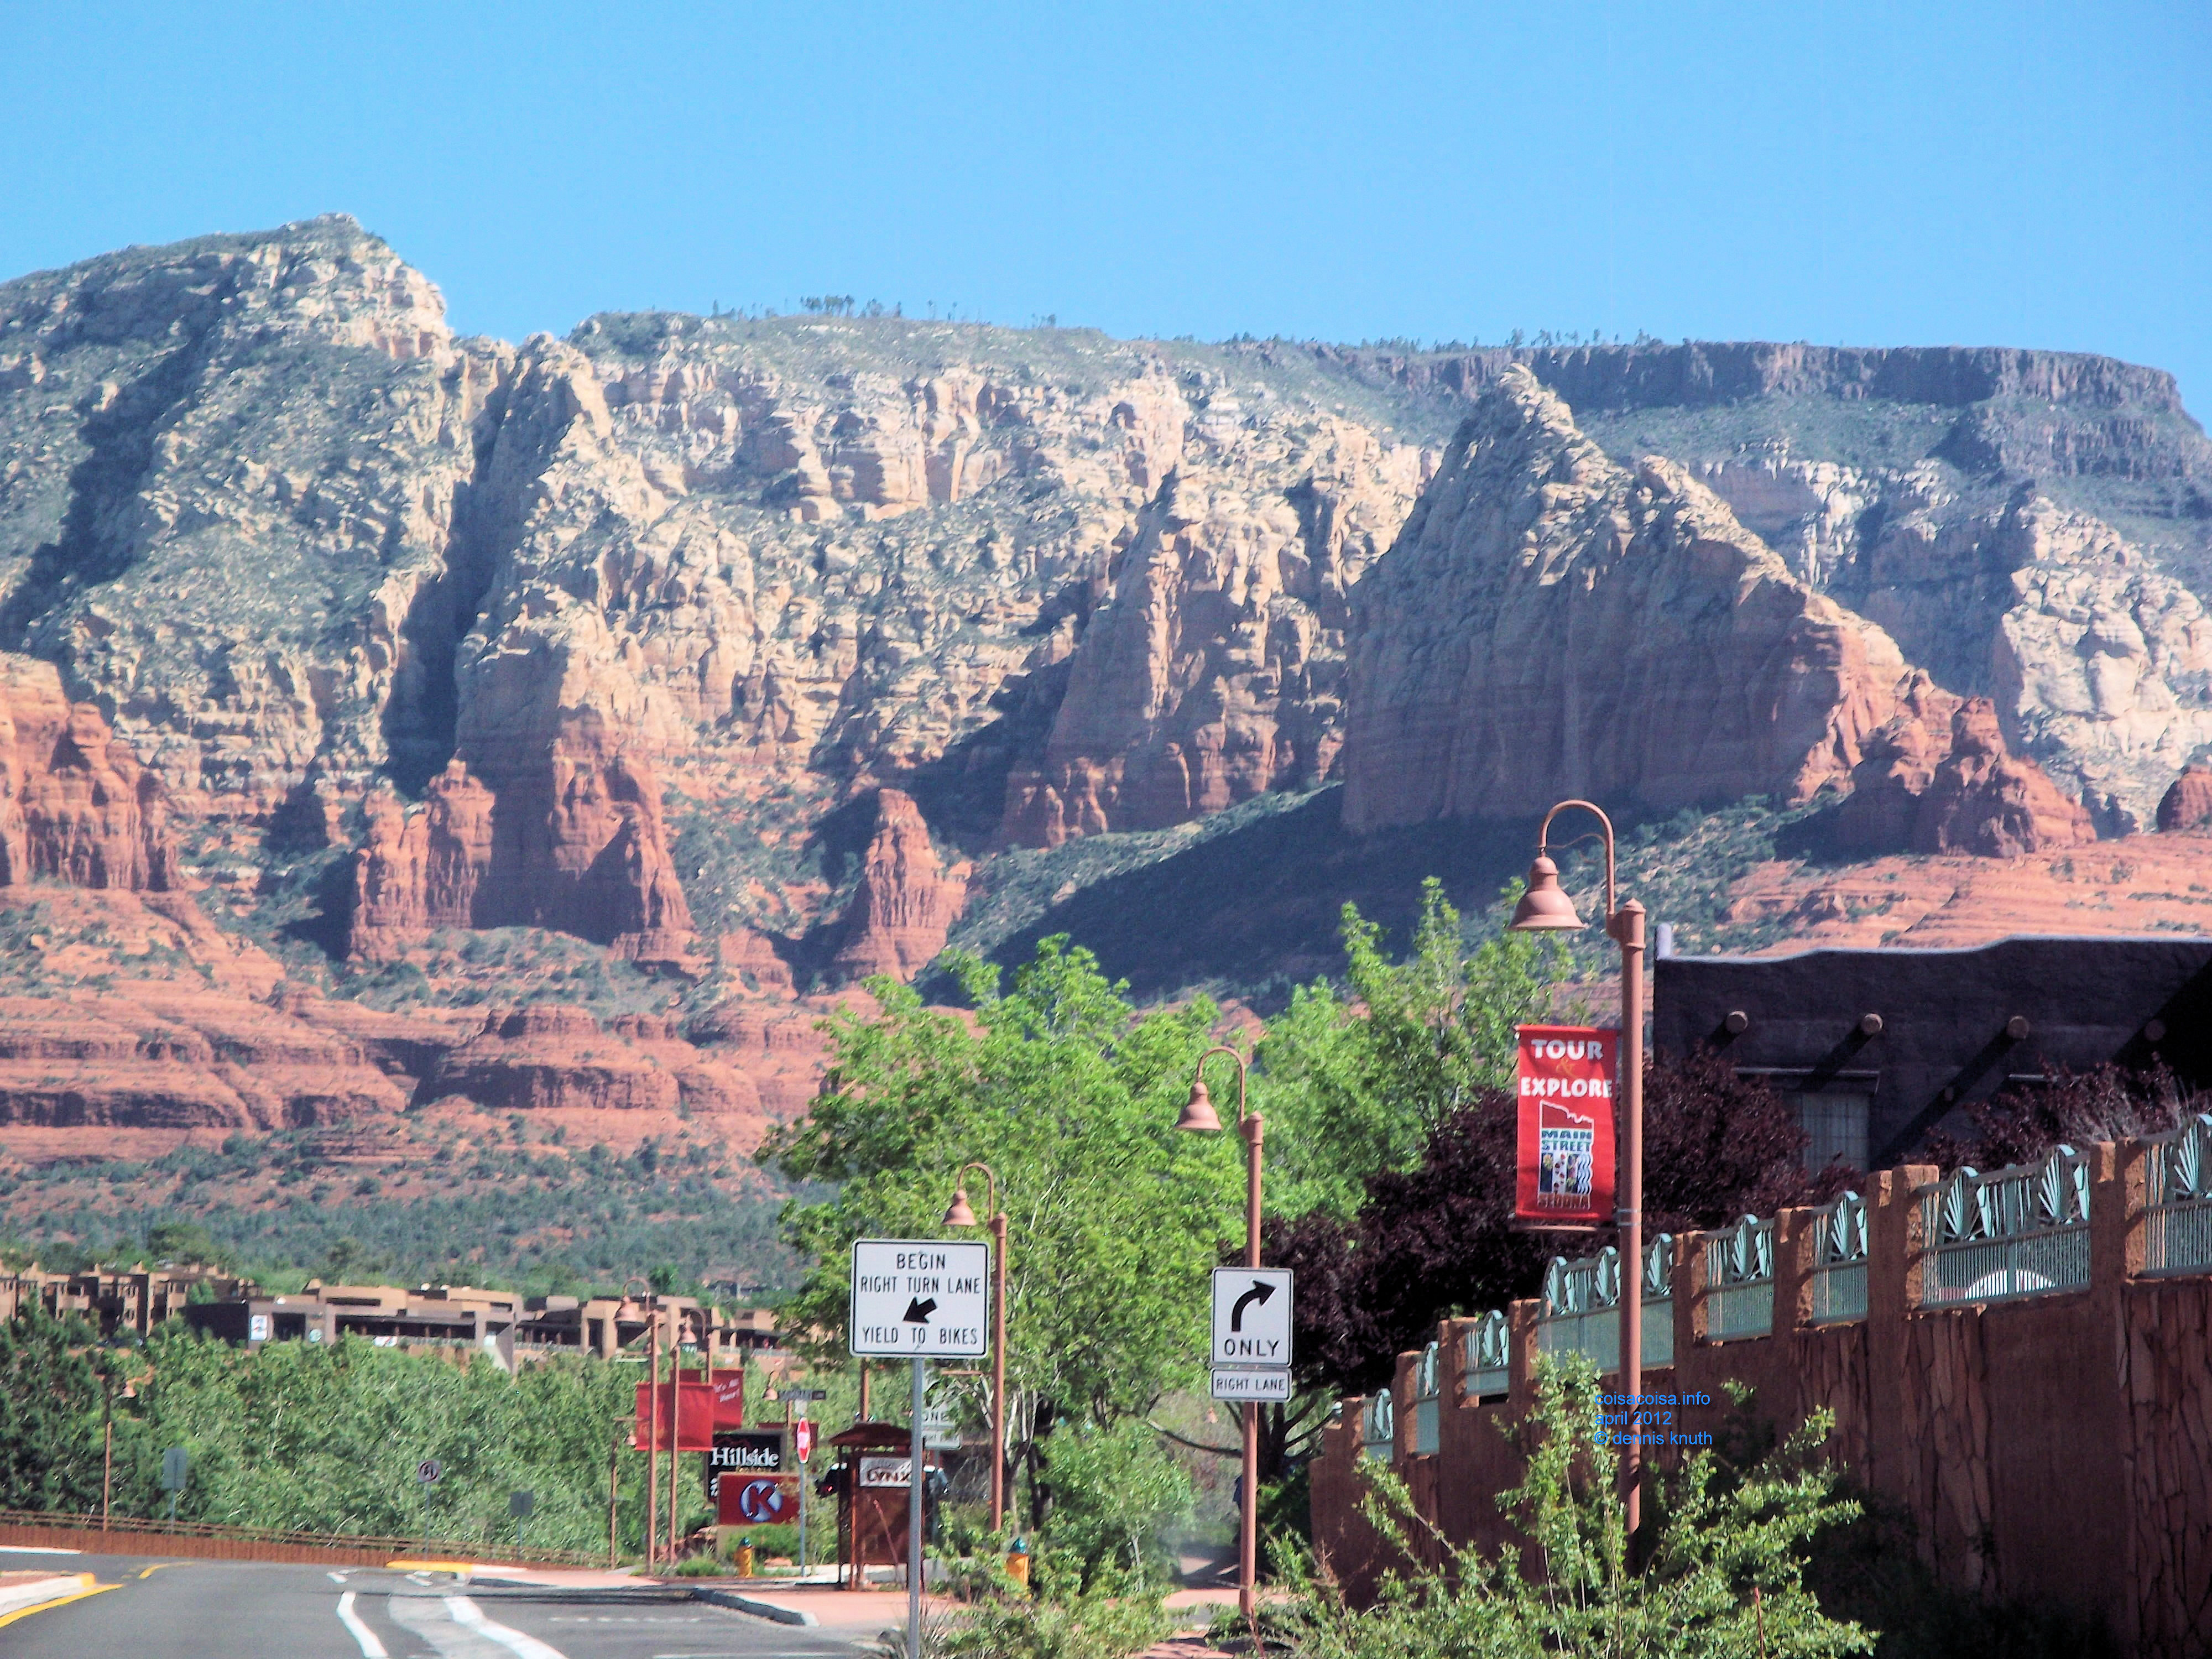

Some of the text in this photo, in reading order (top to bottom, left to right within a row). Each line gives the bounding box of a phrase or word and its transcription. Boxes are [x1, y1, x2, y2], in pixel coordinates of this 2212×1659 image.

[1531, 1039, 1604, 1061] TOUR
[1520, 1077, 1613, 1098] EXPLORE
[1541, 1130, 1592, 1139] MAIN
[1541, 1140, 1592, 1152] STREET
[896, 1253, 946, 1270] BEGIN
[860, 1276, 981, 1294] RIGHT TURN LANE
[862, 1327, 978, 1345] YIELD TO BIKES
[1224, 1338, 1280, 1357] ONLY
[1216, 1378, 1285, 1391] RIGHT LANE
[710, 1447, 780, 1467] Hillside
